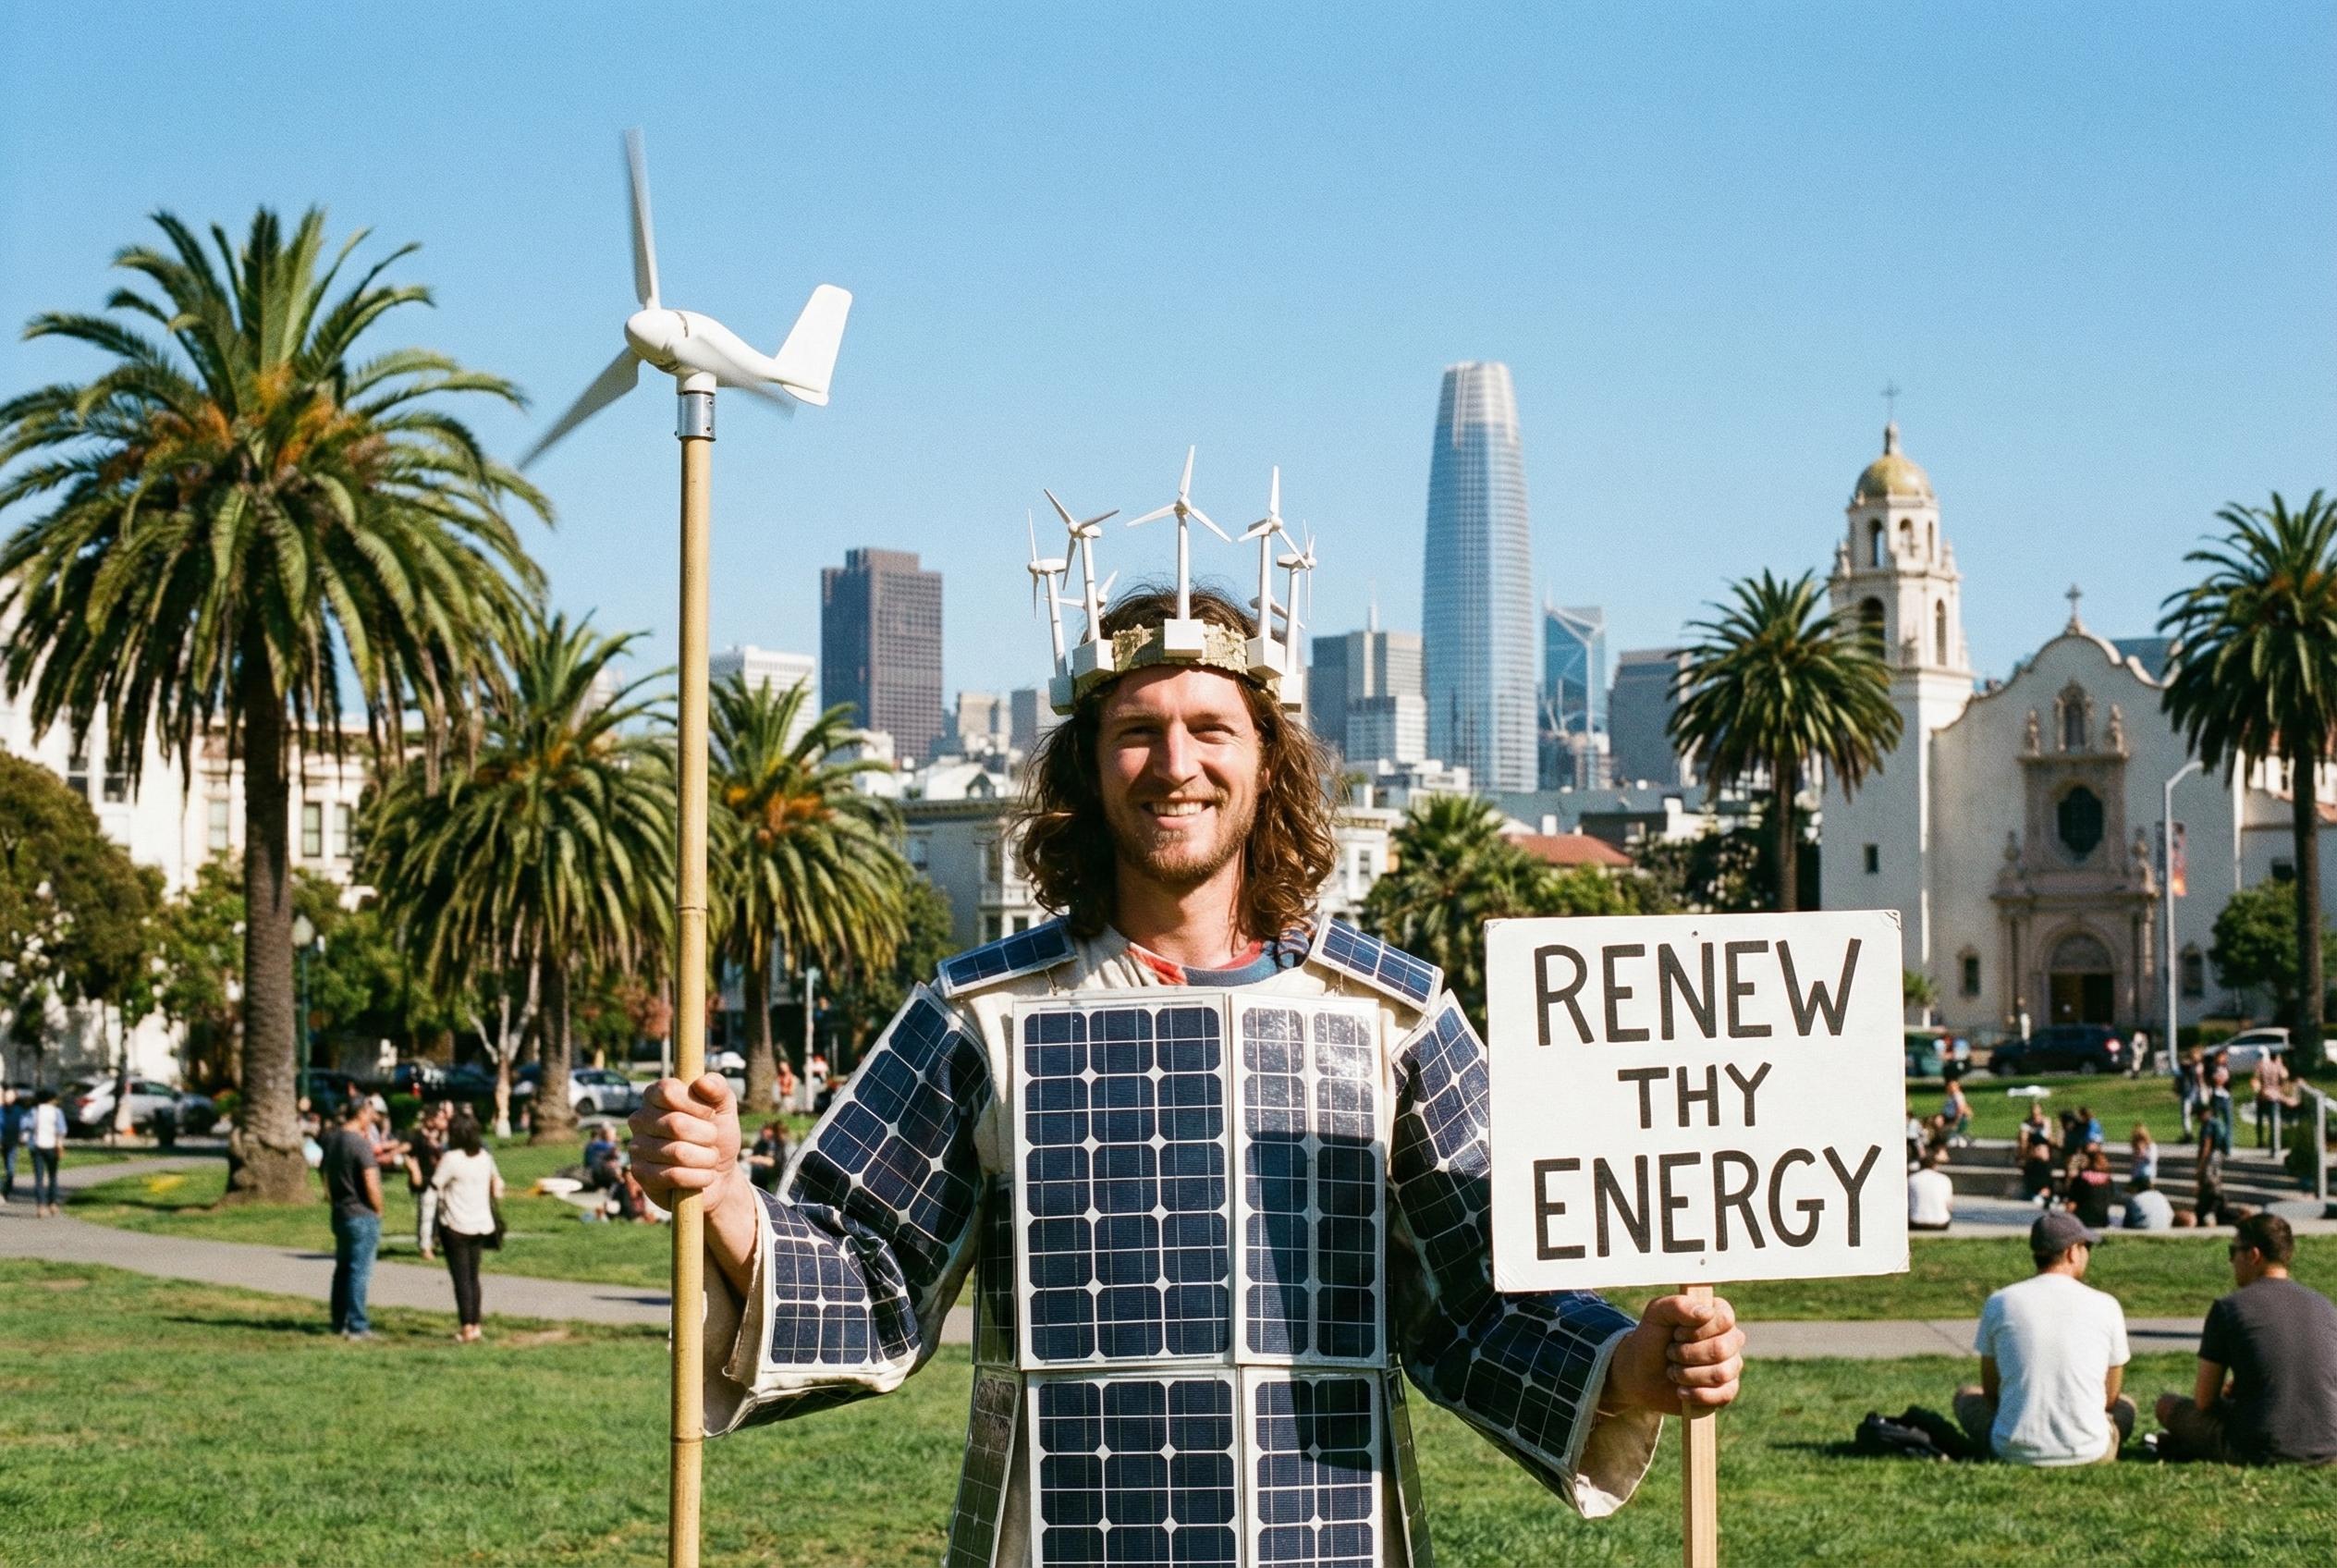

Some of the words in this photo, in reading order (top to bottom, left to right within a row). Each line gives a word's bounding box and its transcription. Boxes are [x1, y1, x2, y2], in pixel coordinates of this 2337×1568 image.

[1534, 937, 1862, 1047] RENEW
[1618, 1061, 1772, 1129] THY
[1533, 1145, 1882, 1261] ENERGY
